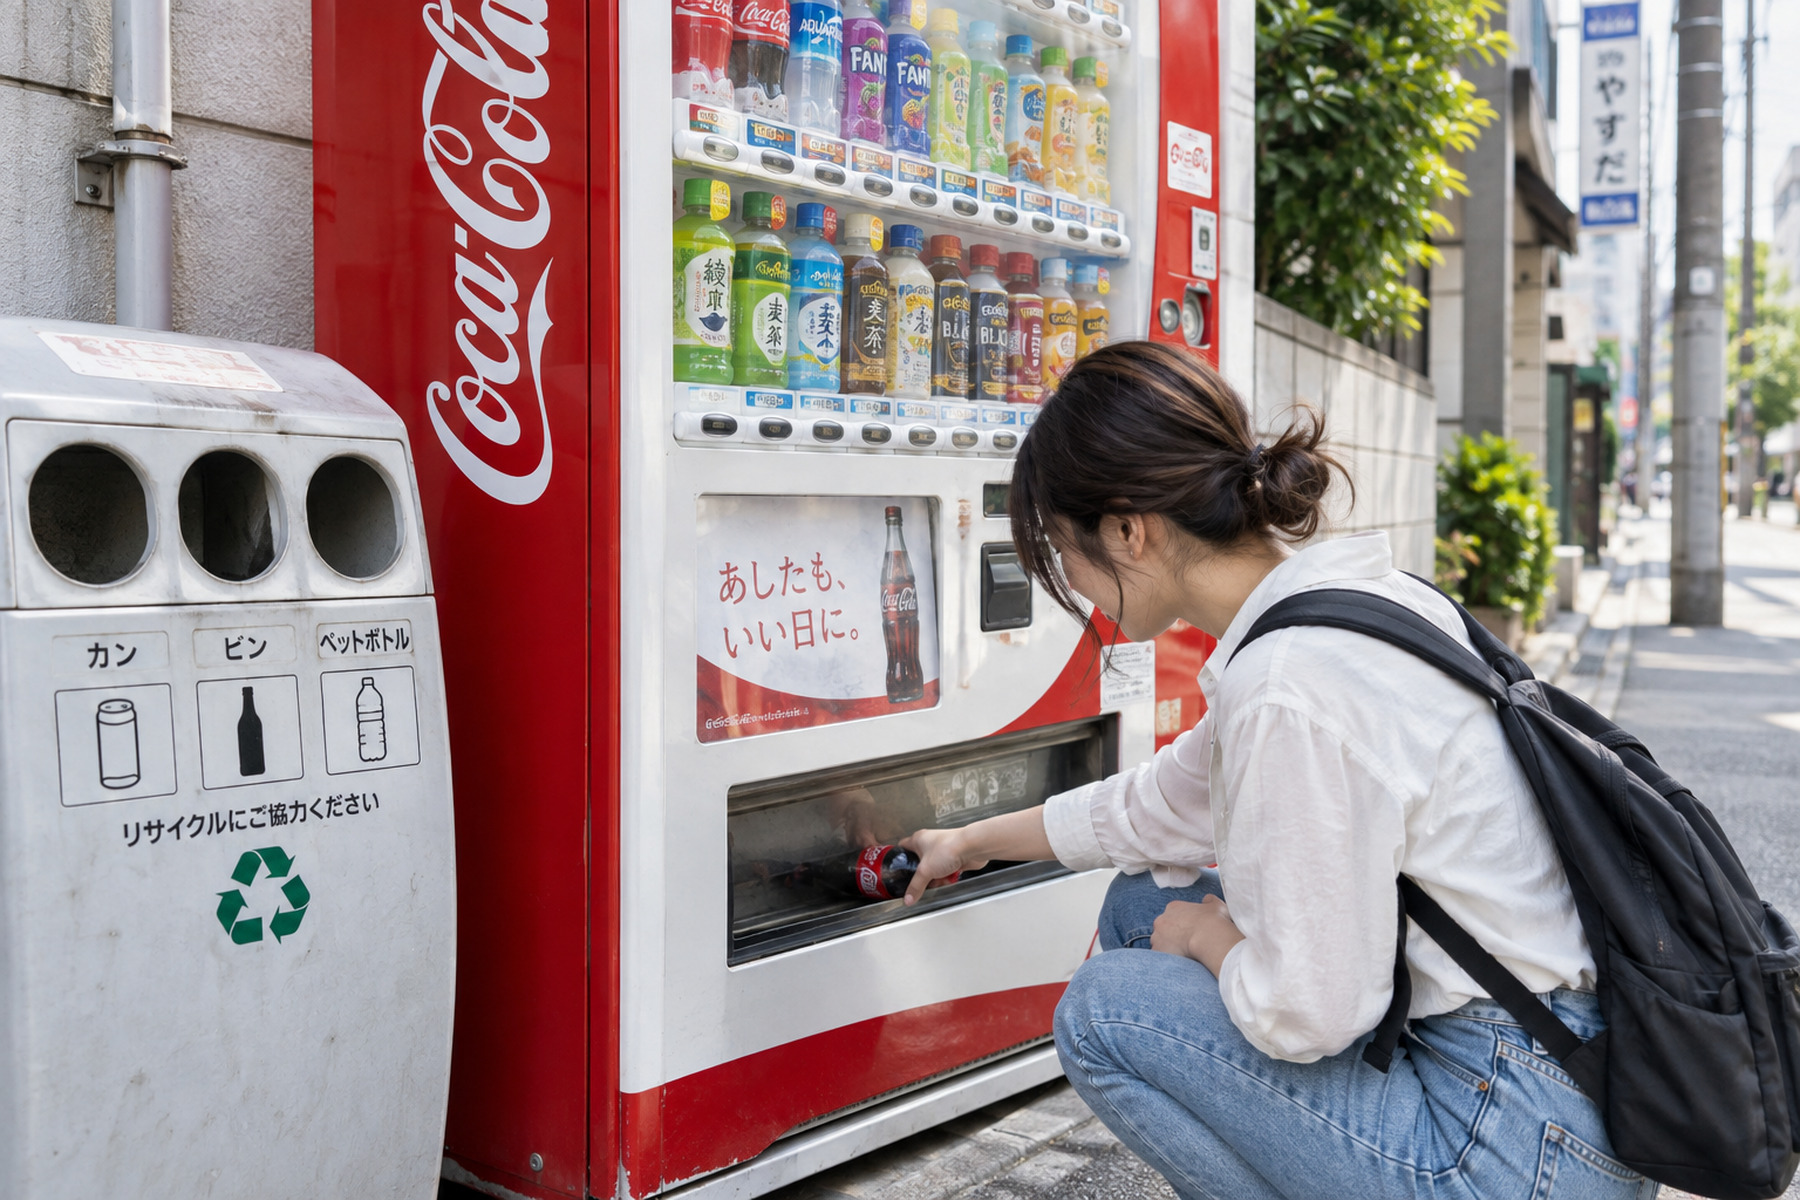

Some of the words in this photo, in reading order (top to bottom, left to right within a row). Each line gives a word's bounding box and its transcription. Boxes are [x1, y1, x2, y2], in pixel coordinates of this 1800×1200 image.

[719, 552, 846, 605] あしたも、
[225, 636, 268, 661] ビン
[320, 628, 411, 655] ペットボトル
[723, 608, 859, 659] いい日に。
[87, 642, 138, 669] カン
[123, 793, 380, 847] リサイクルにご協力ください
